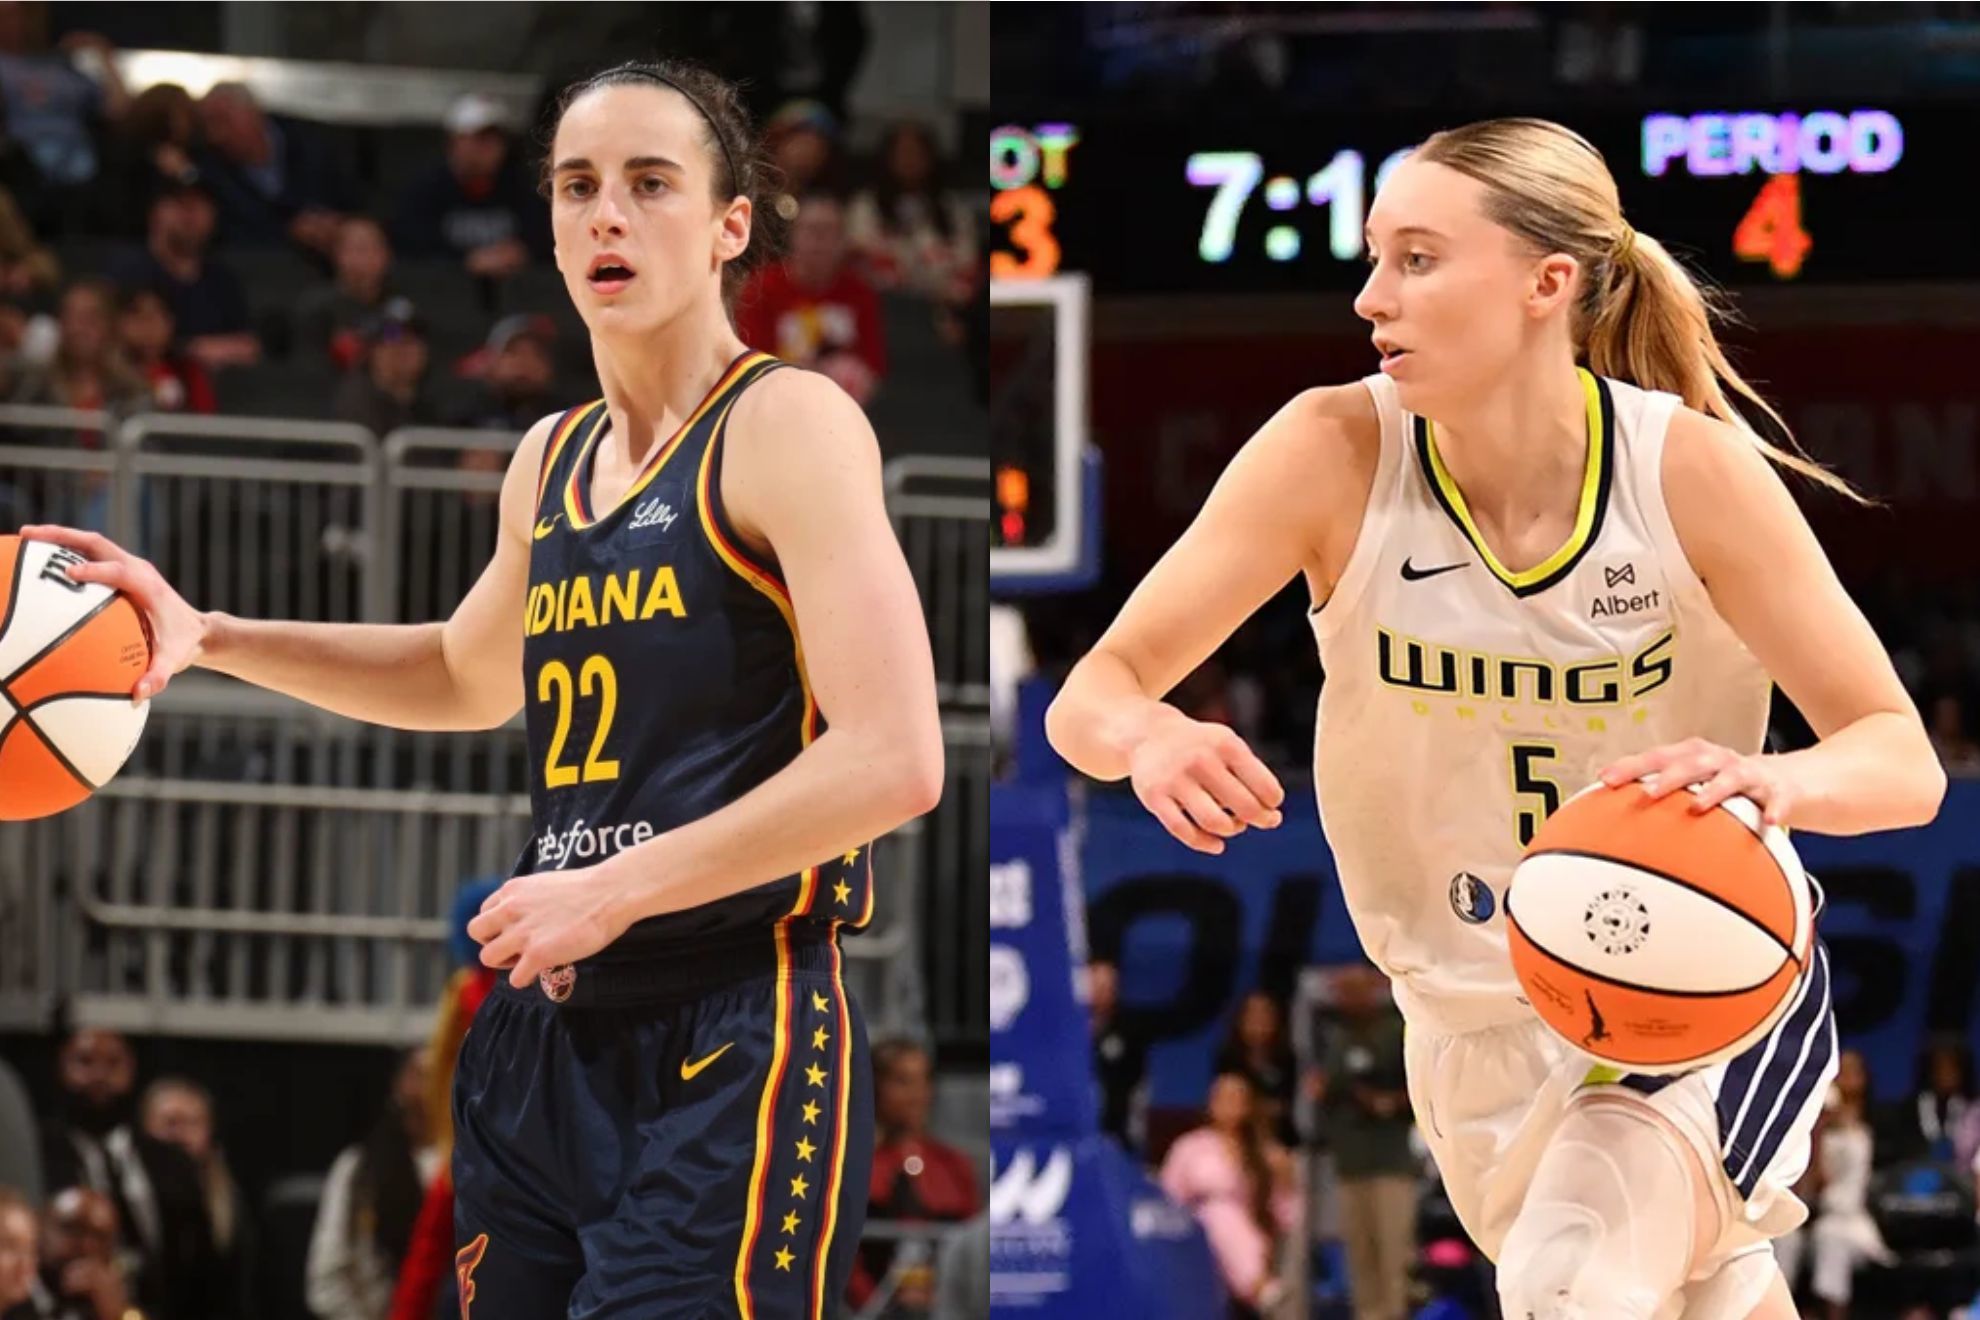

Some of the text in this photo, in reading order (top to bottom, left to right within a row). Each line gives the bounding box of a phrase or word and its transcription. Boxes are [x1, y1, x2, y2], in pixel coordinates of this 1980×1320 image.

[1641, 111, 1904, 176] PERIOD
[990, 184, 1061, 277] 3
[1186, 148, 1416, 262] 7:1
[1732, 173, 1813, 277] 4
[628, 497, 679, 533] Lilly
[1591, 590, 1660, 618] Albert
[1376, 624, 1677, 704] WINGS
[538, 654, 619, 790] 22
[1511, 740, 1561, 849] 5
